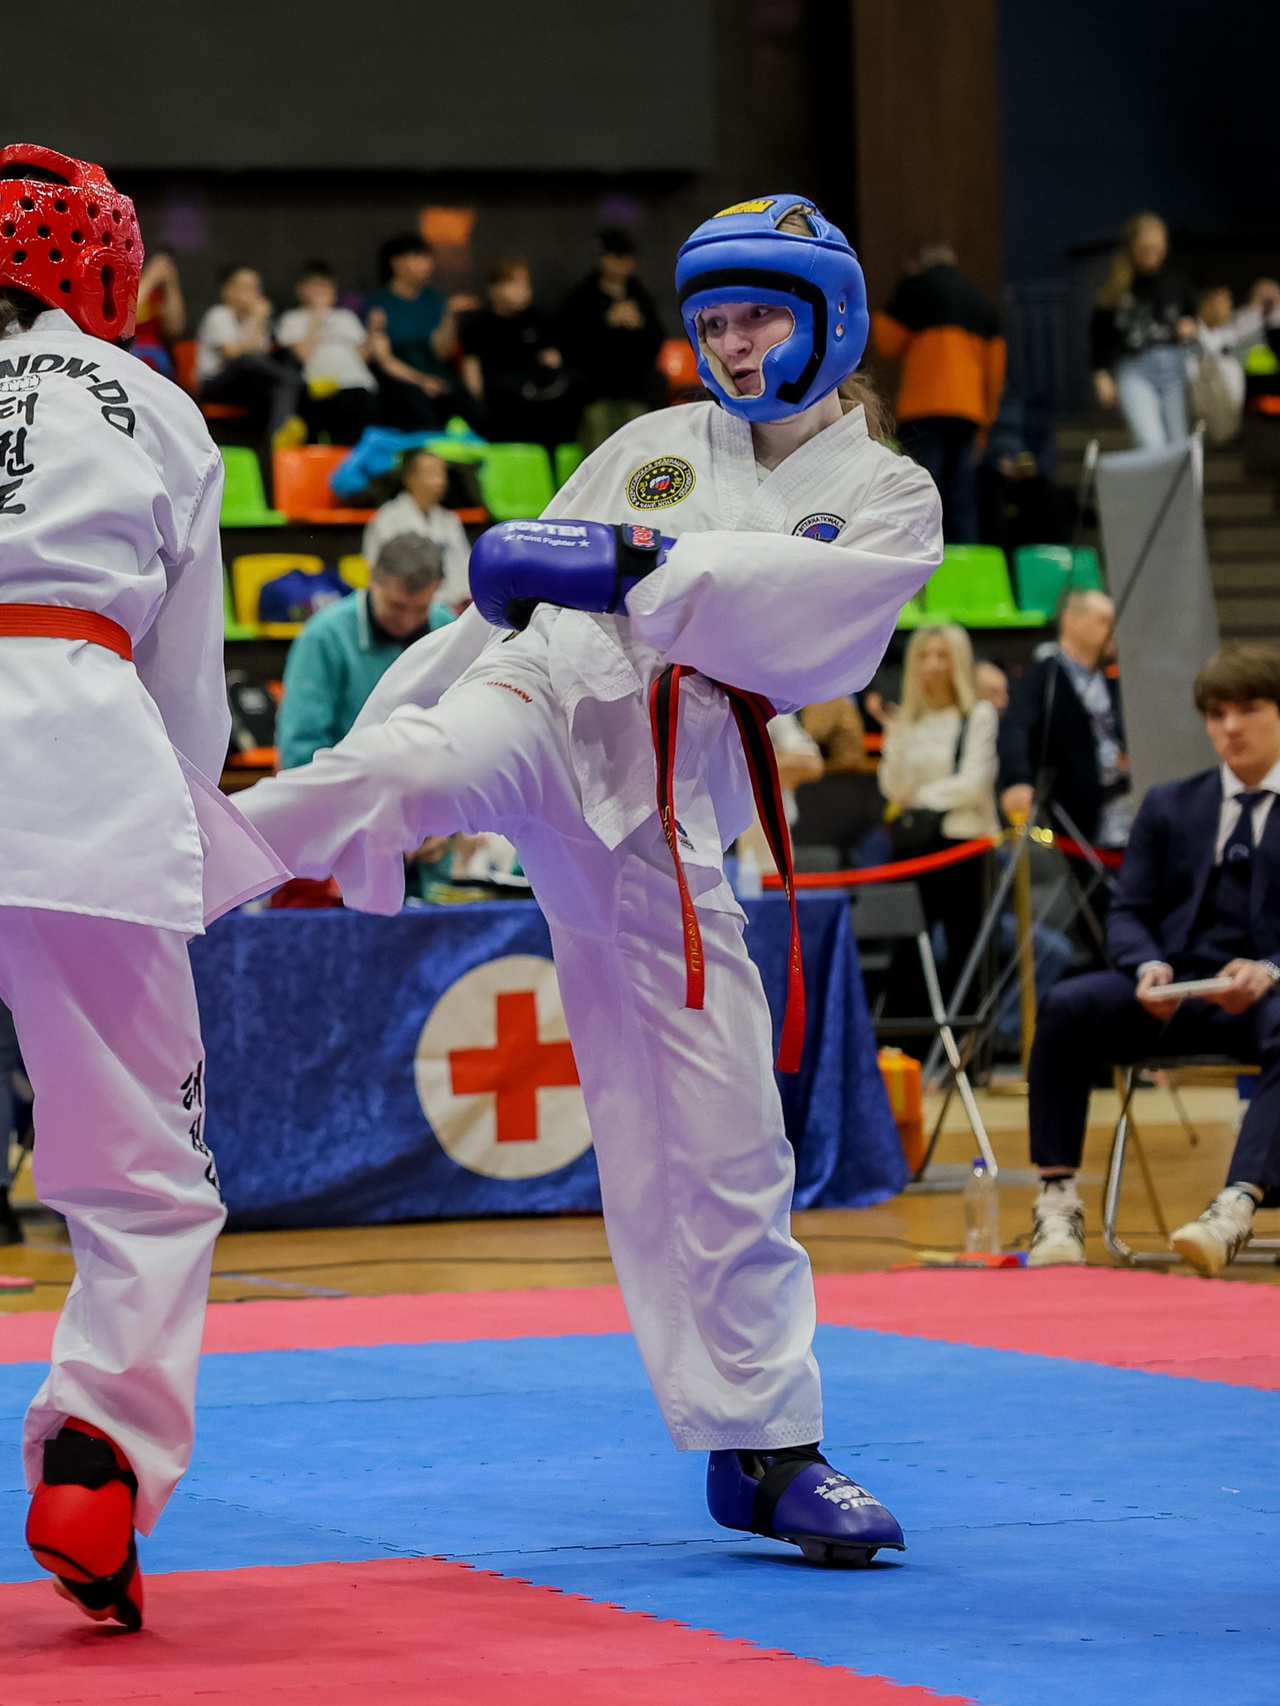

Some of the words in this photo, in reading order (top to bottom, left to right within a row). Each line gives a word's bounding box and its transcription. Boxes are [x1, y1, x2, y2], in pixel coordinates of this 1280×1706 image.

[503, 521, 545, 532] TOP
[545, 523, 588, 538] TEN
[798, 516, 841, 533] INTERNATIONAL
